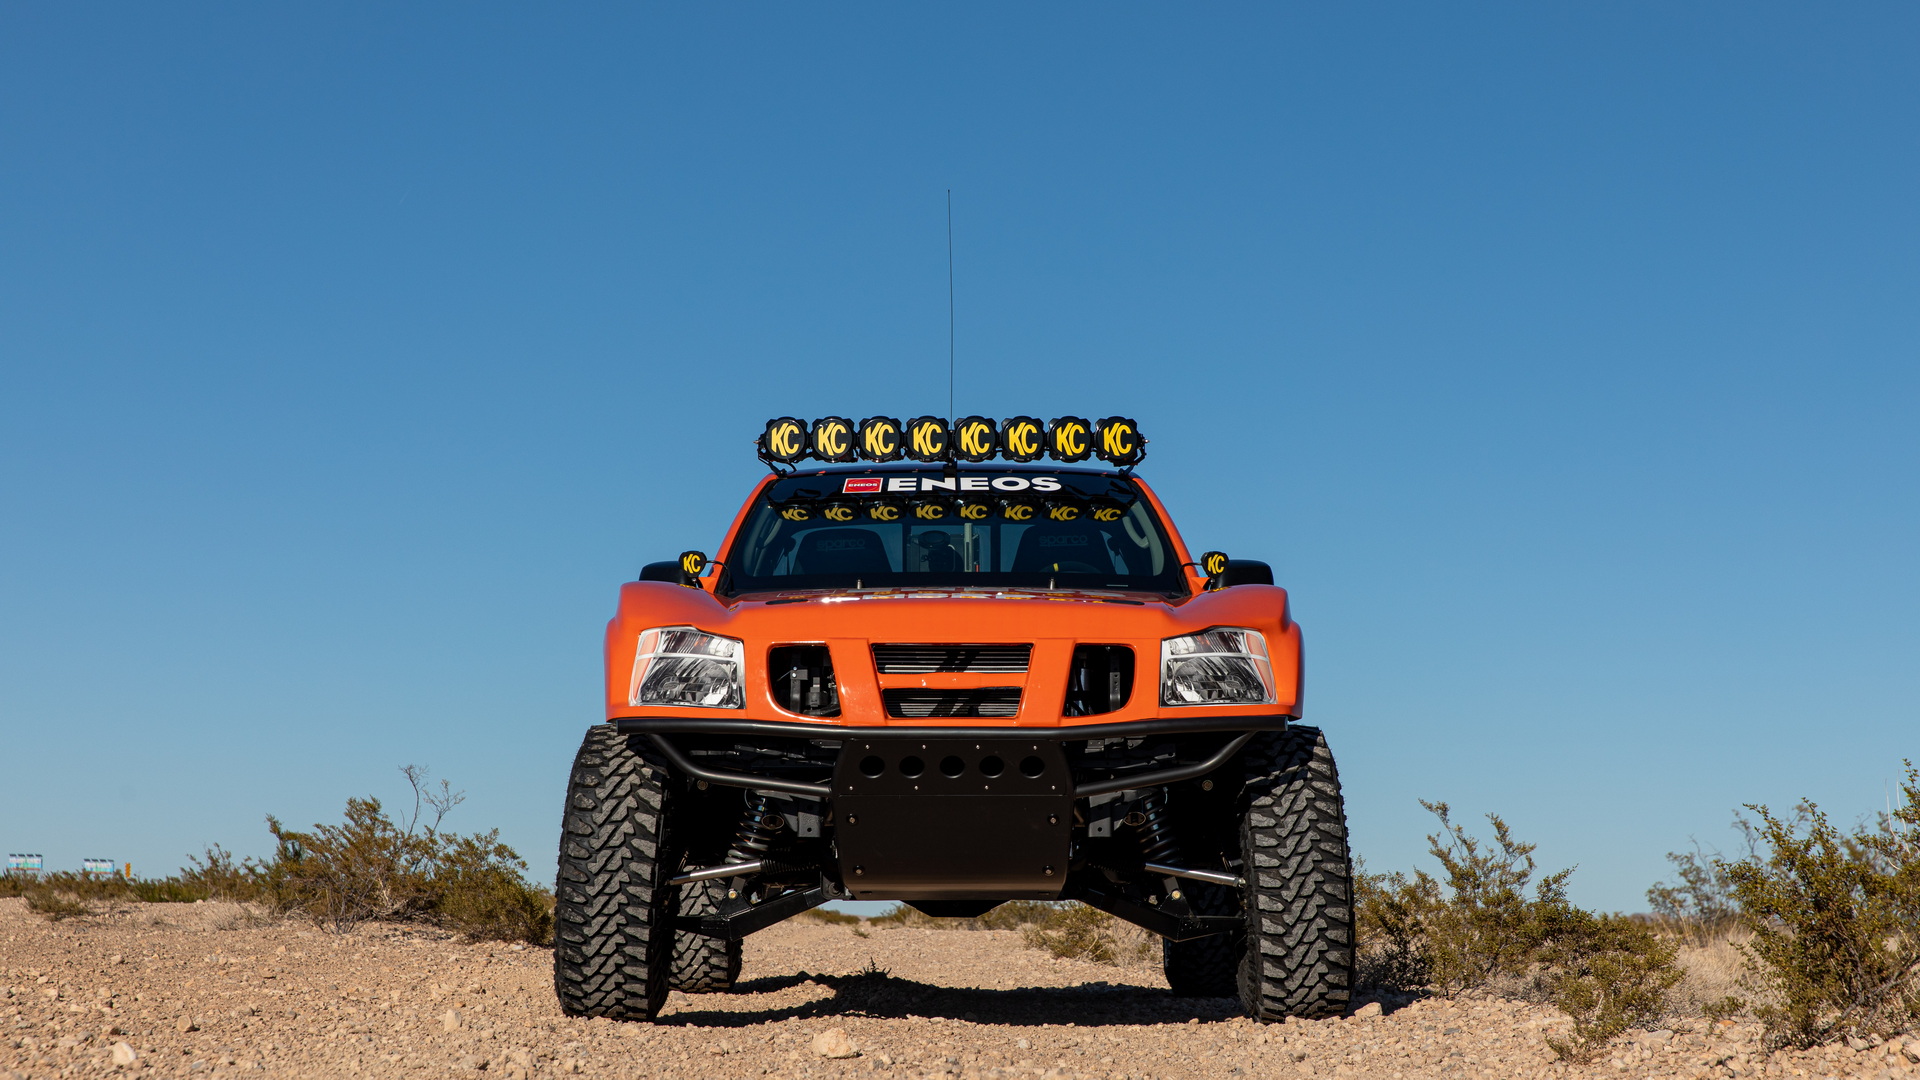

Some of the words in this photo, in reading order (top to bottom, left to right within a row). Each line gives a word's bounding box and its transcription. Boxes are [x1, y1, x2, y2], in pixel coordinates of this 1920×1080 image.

[771, 423, 799, 456] KC
[818, 422, 847, 456] KC
[865, 422, 894, 456] KC
[913, 422, 942, 456] KC
[961, 422, 990, 456] KC
[1008, 422, 1037, 456] KC
[1056, 422, 1085, 456] KC
[1104, 423, 1132, 456] KC
[887, 477, 1062, 491] ENEOS
[683, 554, 701, 574] KC
[1207, 554, 1225, 574] KC
